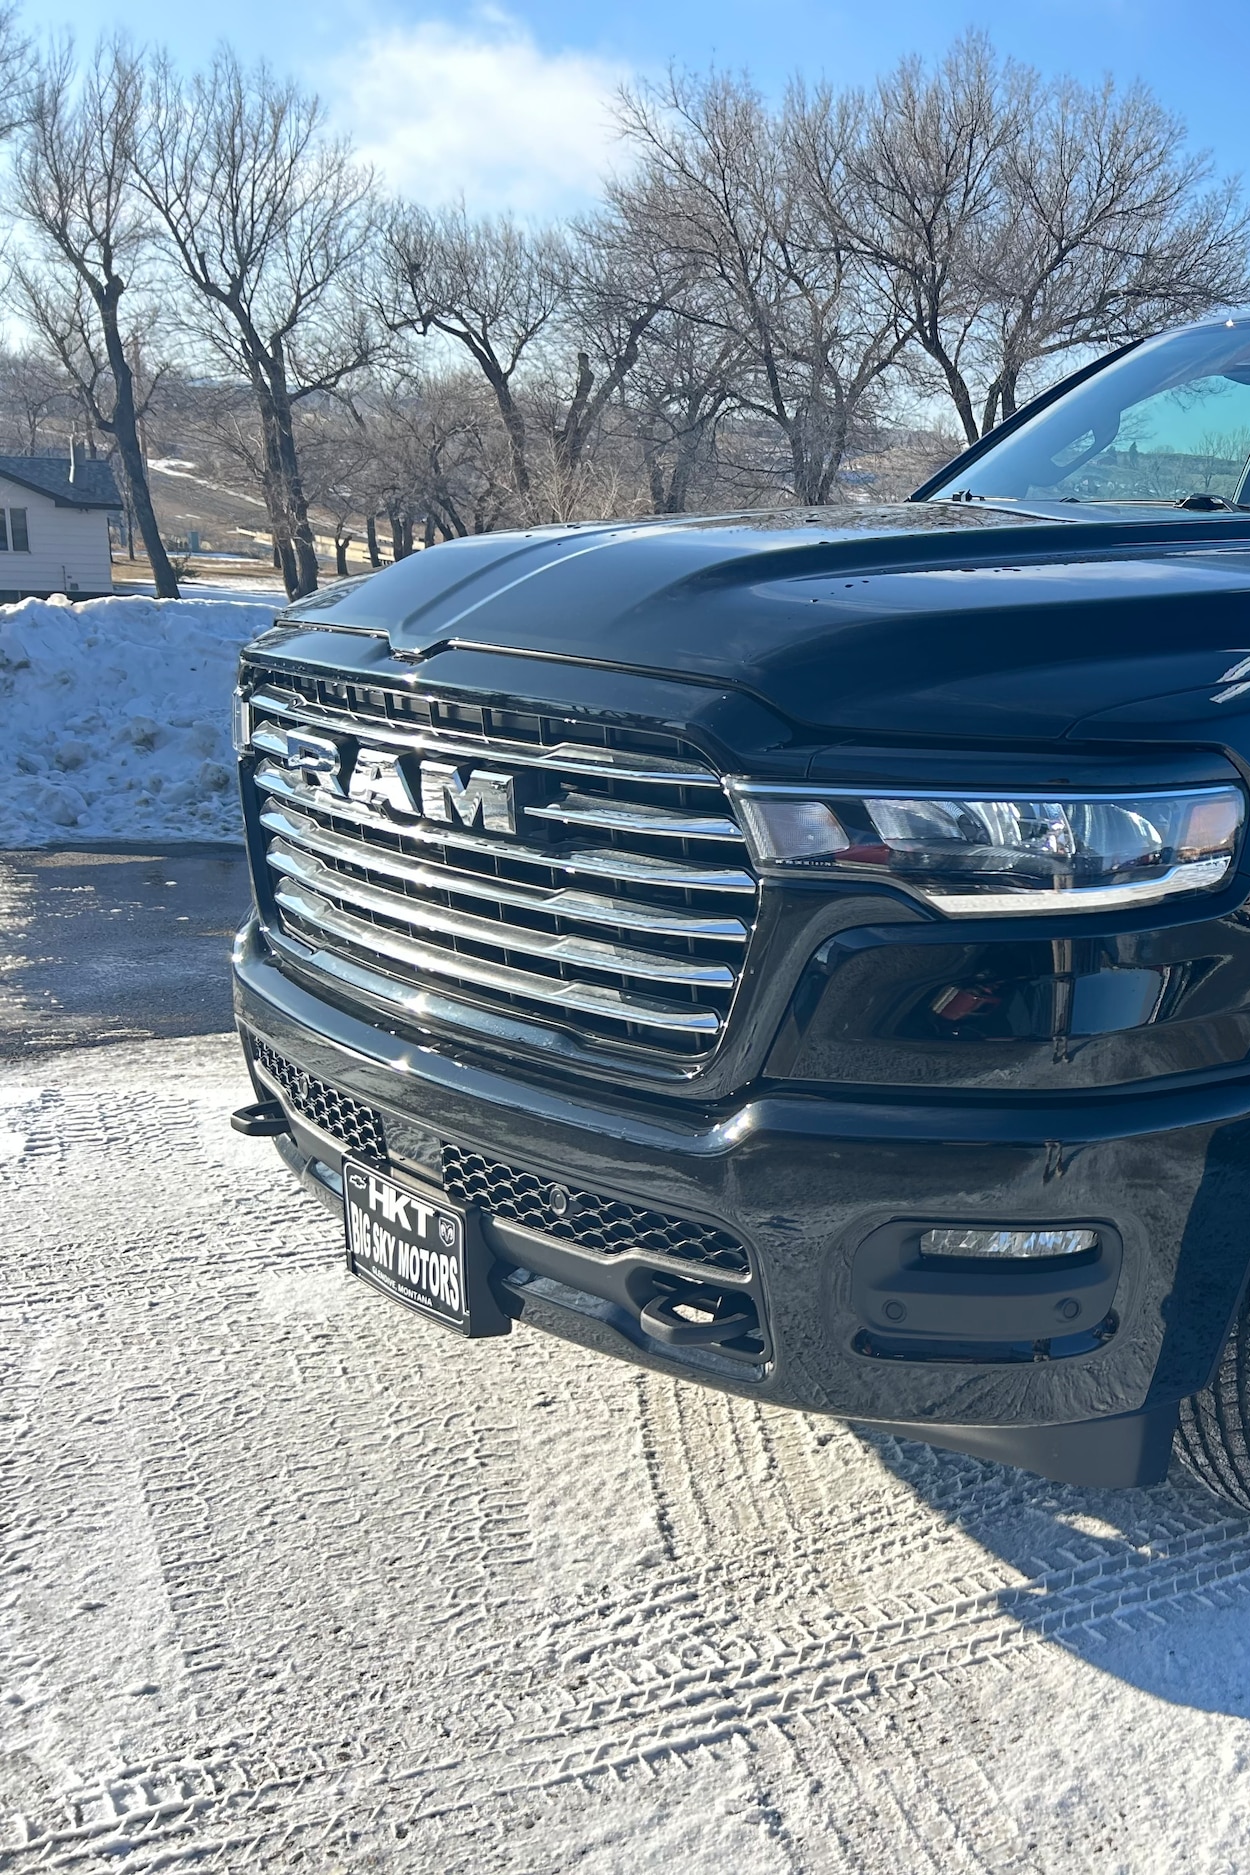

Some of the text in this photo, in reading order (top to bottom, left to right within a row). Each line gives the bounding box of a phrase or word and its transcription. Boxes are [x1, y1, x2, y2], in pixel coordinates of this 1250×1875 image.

[286, 728, 517, 836] RAM
[369, 1176, 435, 1238] HKT
[351, 1201, 460, 1312] BIG SKY MOTORS
[397, 1283, 433, 1308] MONTANA
